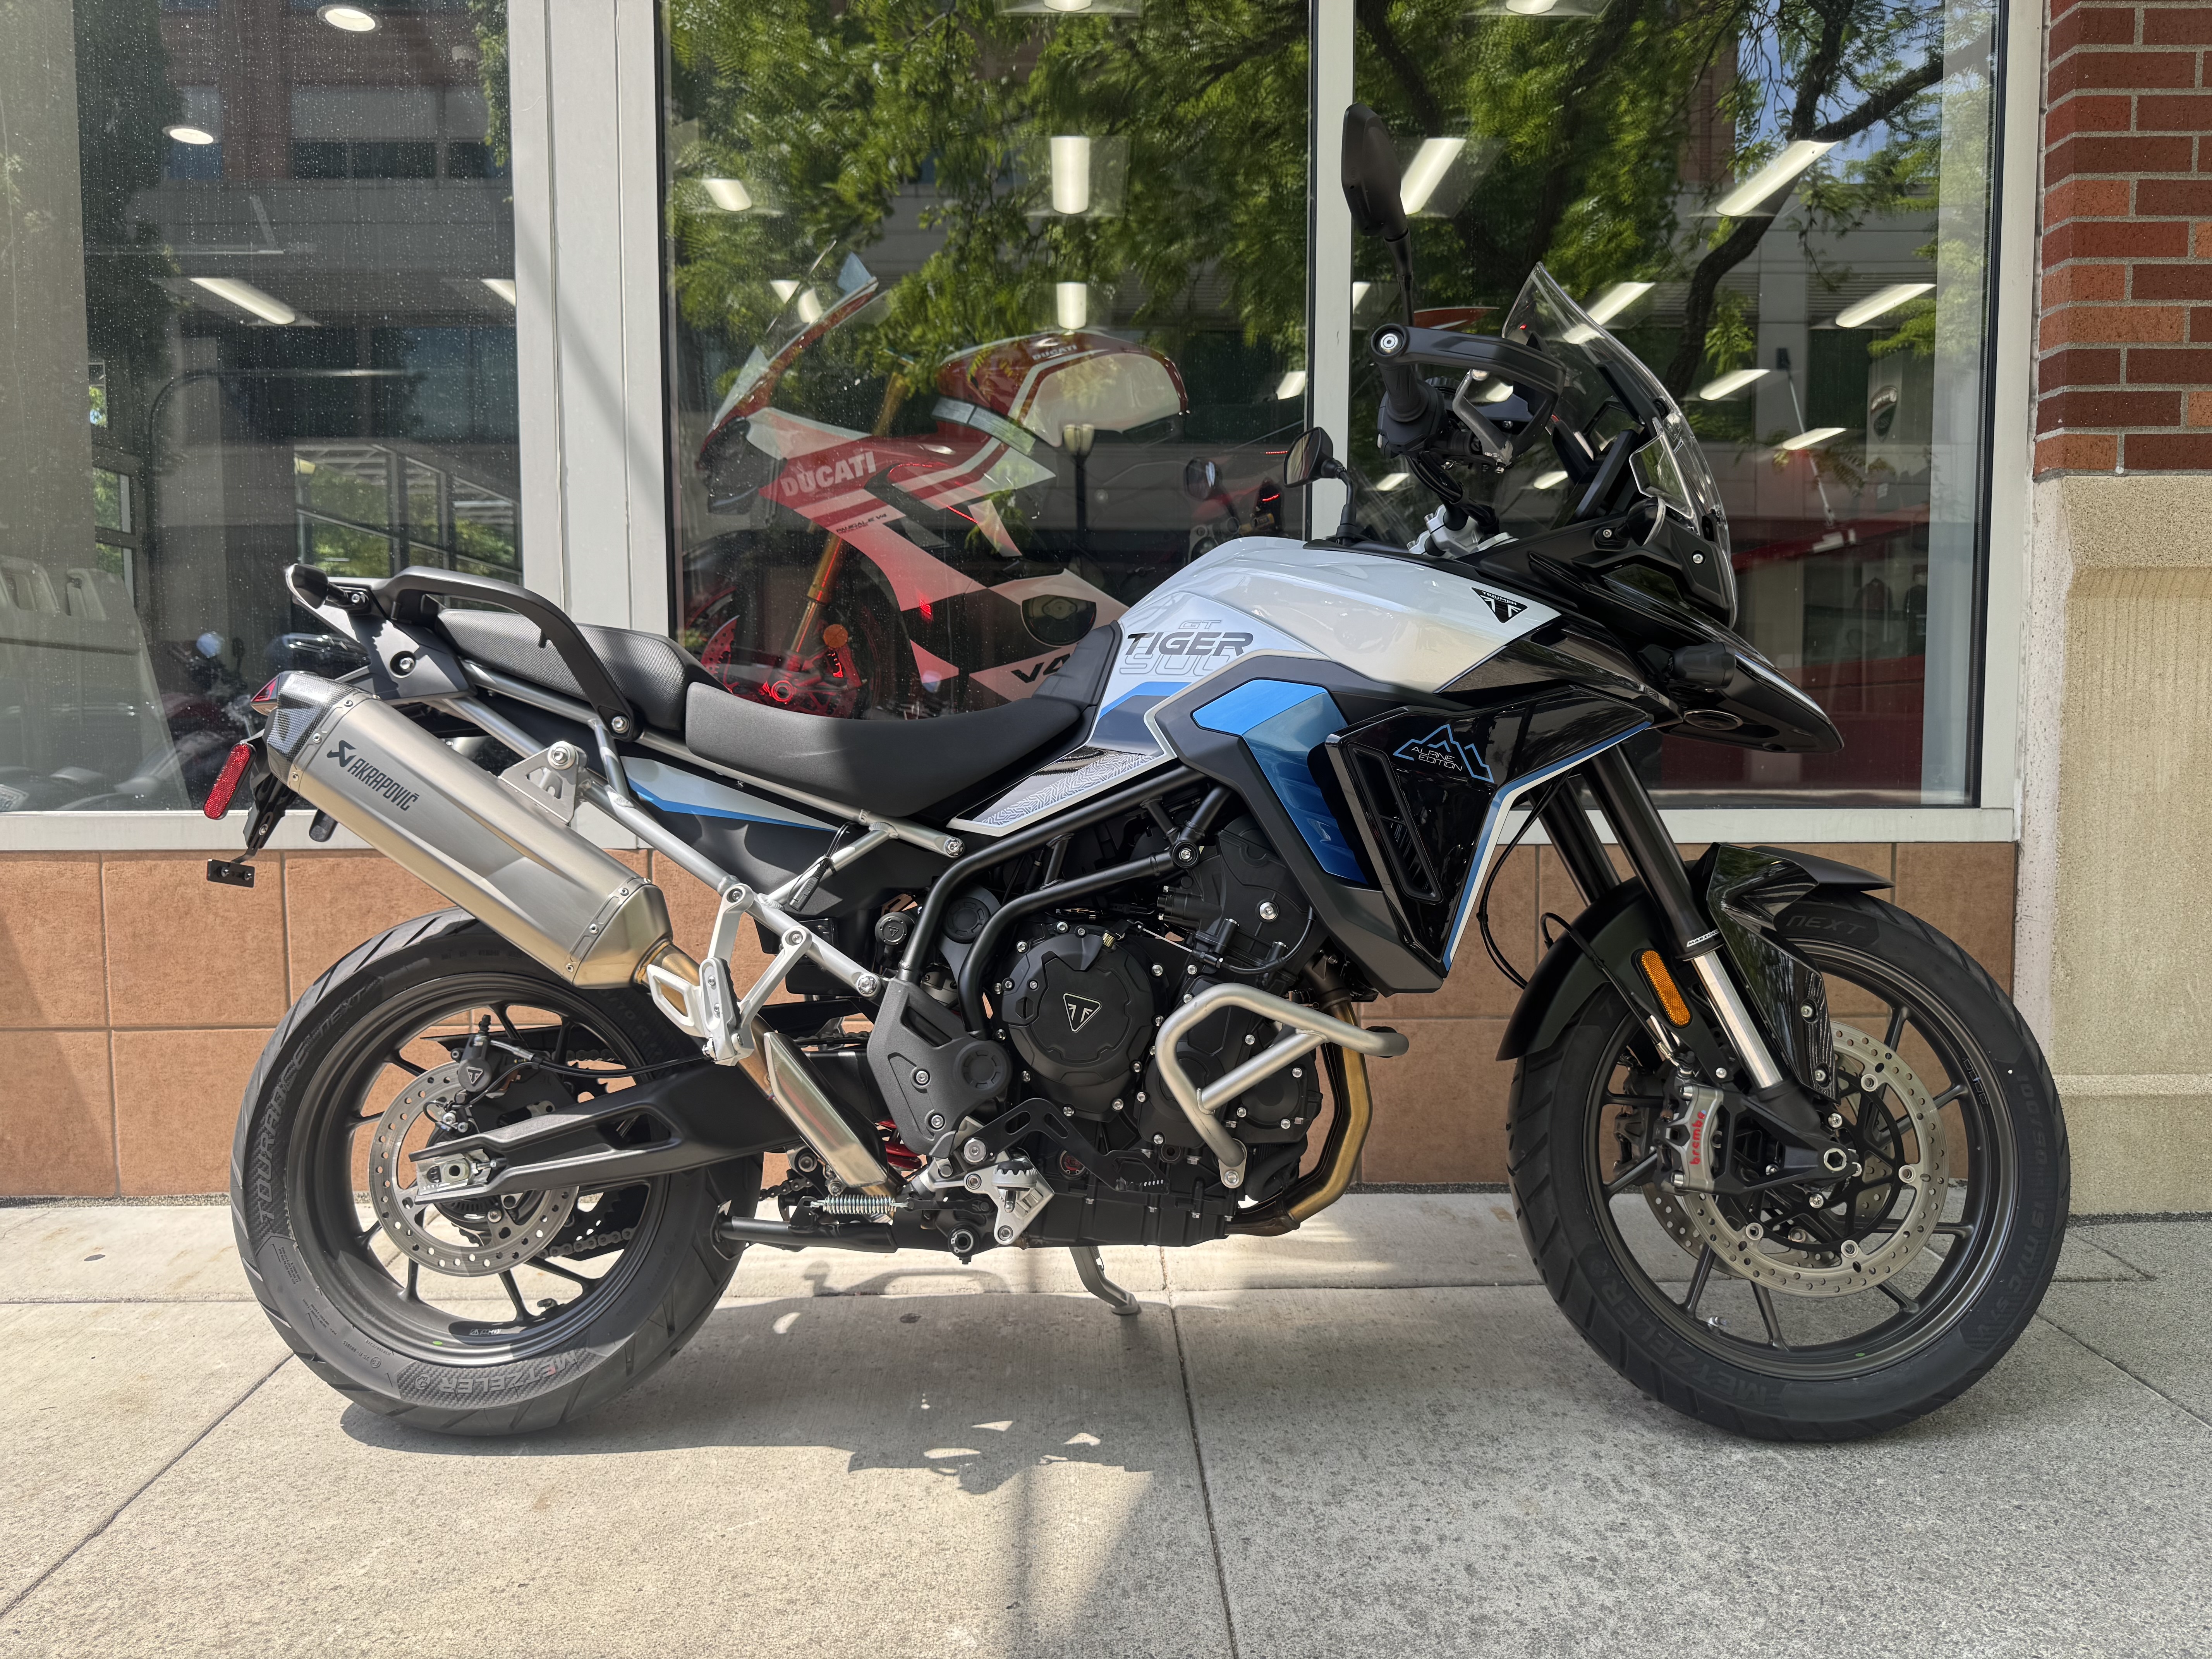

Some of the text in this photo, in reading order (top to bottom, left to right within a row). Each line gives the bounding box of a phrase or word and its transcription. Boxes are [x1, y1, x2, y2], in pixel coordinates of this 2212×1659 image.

[1032, 344, 1078, 361] DUCATI
[780, 451, 876, 496] DUCATI
[1482, 591, 1517, 606] TRIUMPH
[1179, 620, 1222, 630] GT
[1125, 632, 1254, 656] TIGER
[1011, 653, 1071, 684] V4
[1411, 747, 1455, 763] ALPINE
[1418, 754, 1463, 771] EDITION
[1689, 1111, 1705, 1165] brembo
[1602, 1280, 1767, 1405] METZELER
[440, 1349, 577, 1393] METZELER
